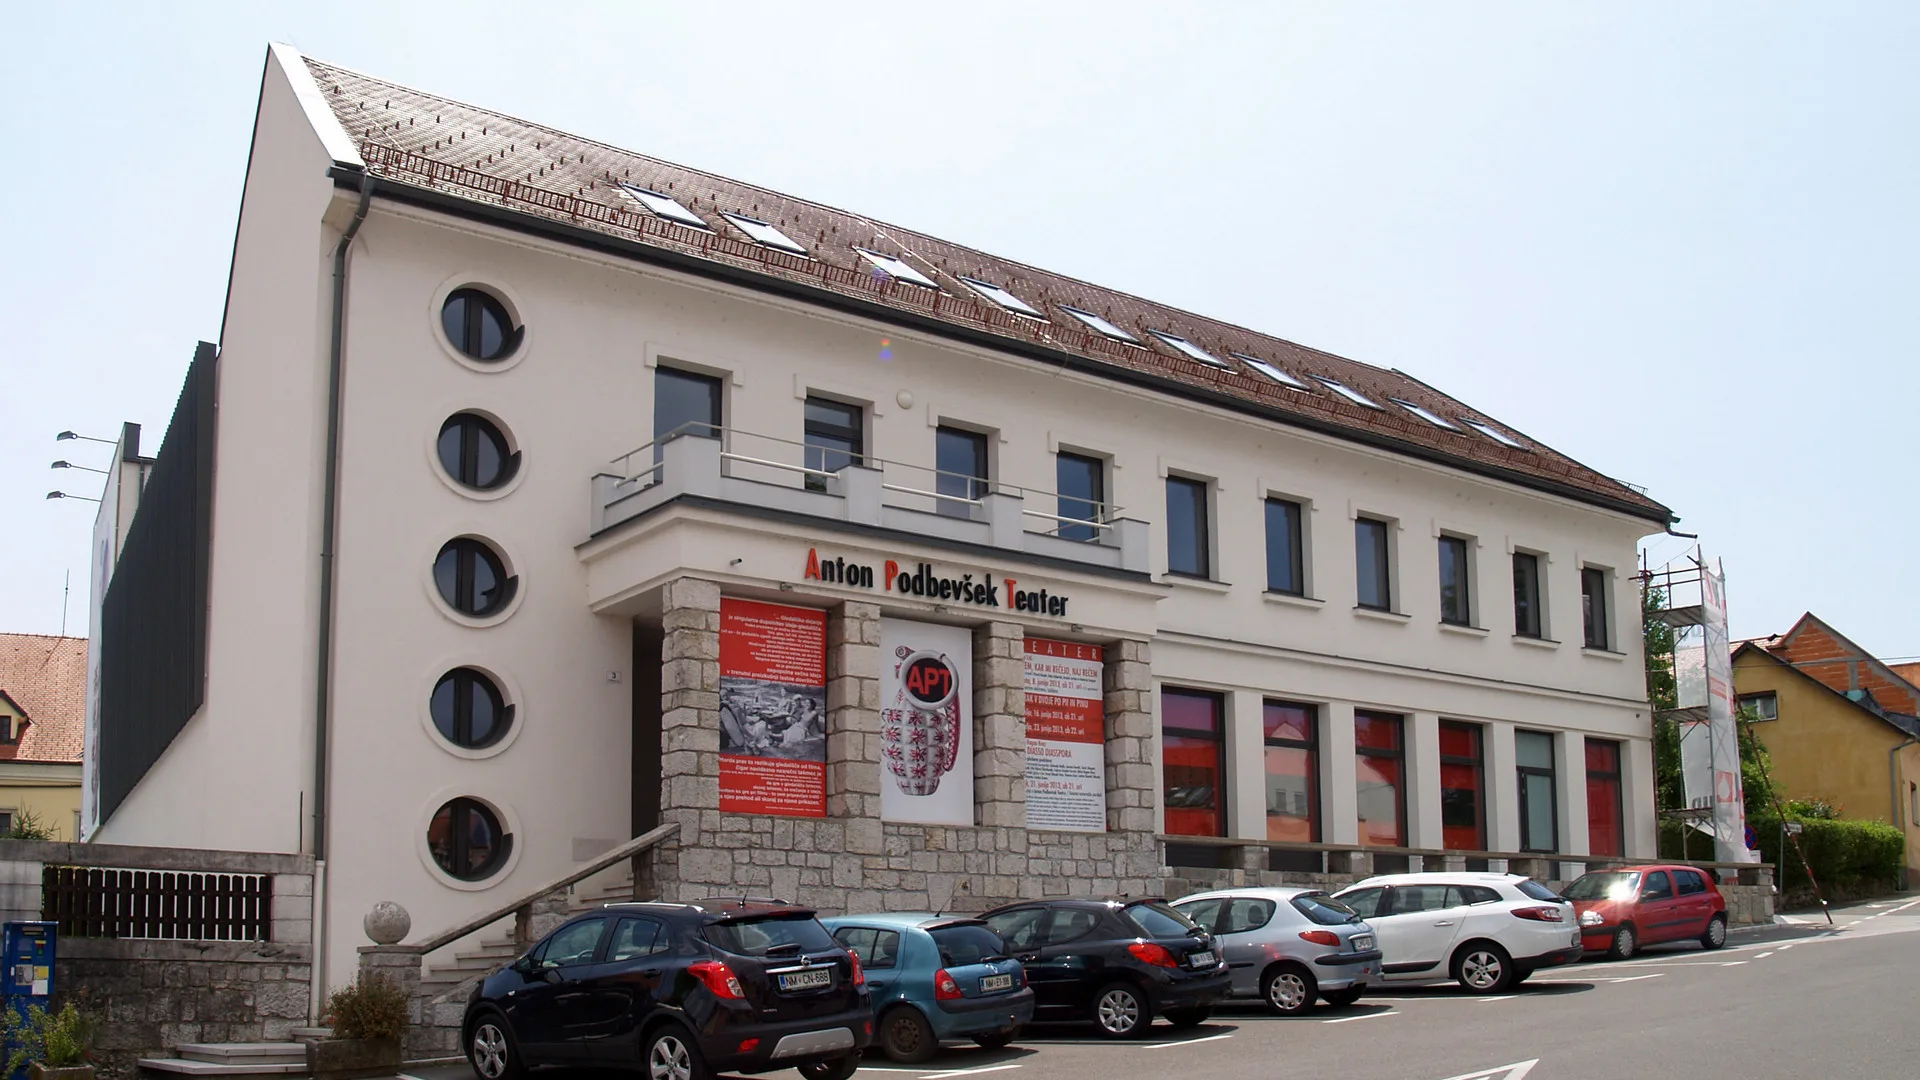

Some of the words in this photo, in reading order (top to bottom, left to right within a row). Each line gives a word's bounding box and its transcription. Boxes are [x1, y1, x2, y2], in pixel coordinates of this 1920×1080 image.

[805, 548, 873, 588] Anton
[884, 560, 999, 606] Podbevšek
[1004, 578, 1069, 616] Teater
[1032, 641, 1097, 660] EATER
[1035, 663, 1044, 672] KAR
[1052, 664, 1071, 675] REČEJO,
[1082, 667, 1098, 677] REČEM
[907, 665, 951, 696] APT
[786, 976, 797, 985] NM
[803, 972, 828, 984] CN-688
